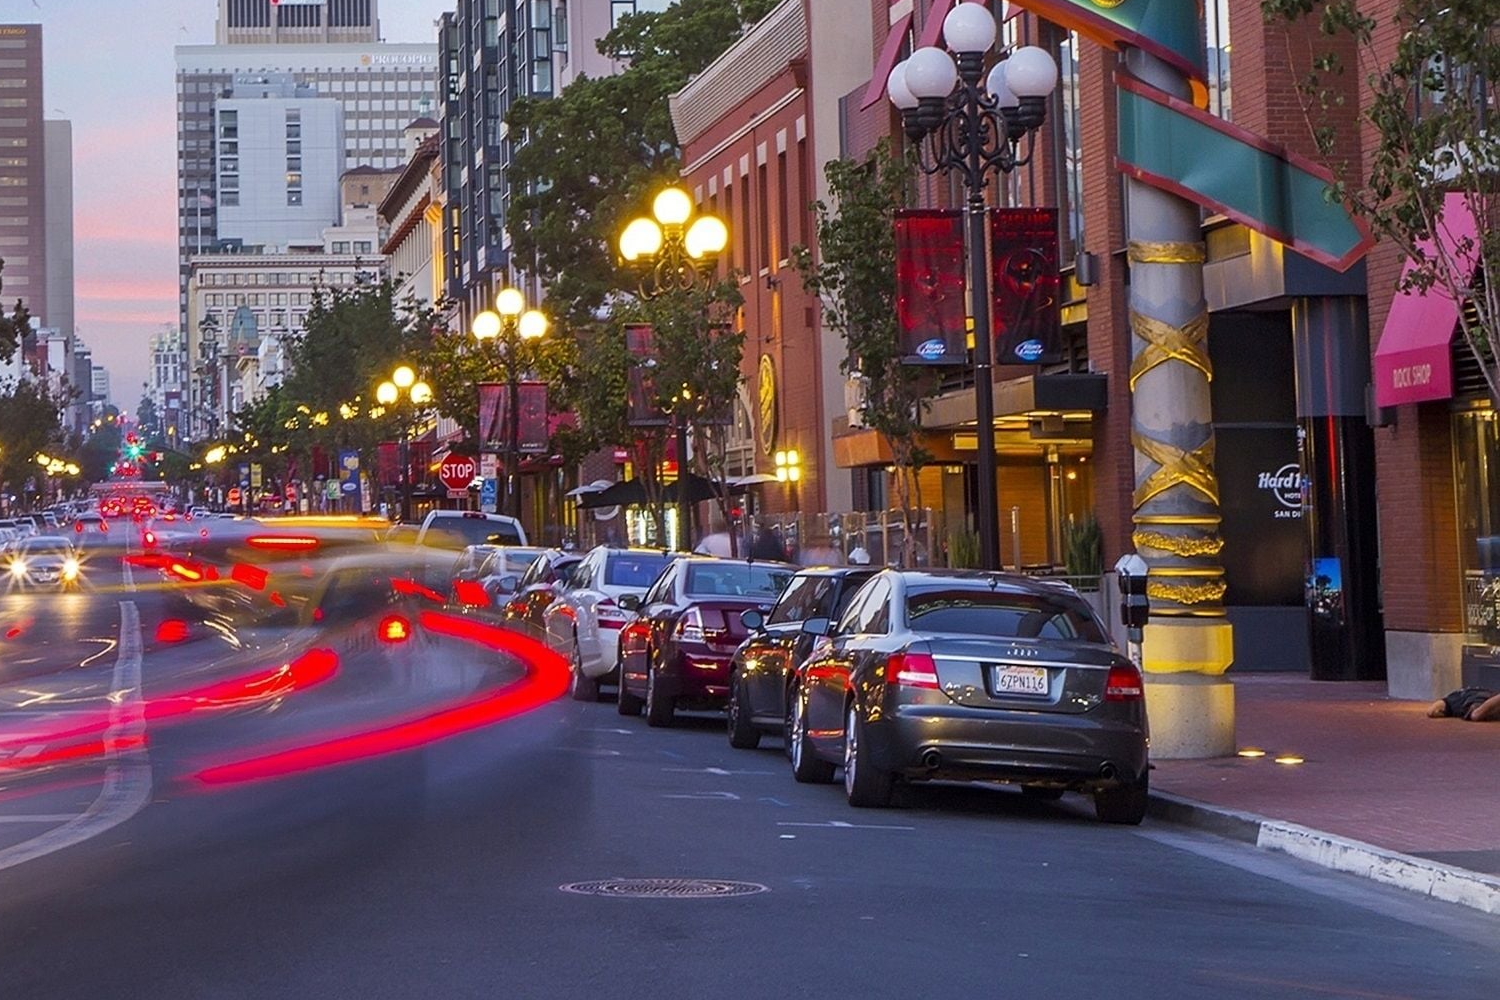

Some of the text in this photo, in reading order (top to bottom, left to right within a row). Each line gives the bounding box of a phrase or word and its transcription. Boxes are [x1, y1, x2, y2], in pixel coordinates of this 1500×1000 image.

[371, 54, 433, 65] PROCOPIO
[1393, 363, 1432, 389] ROCK SHOP
[442, 463, 473, 479] STOP
[1258, 472, 1294, 489] Hard
